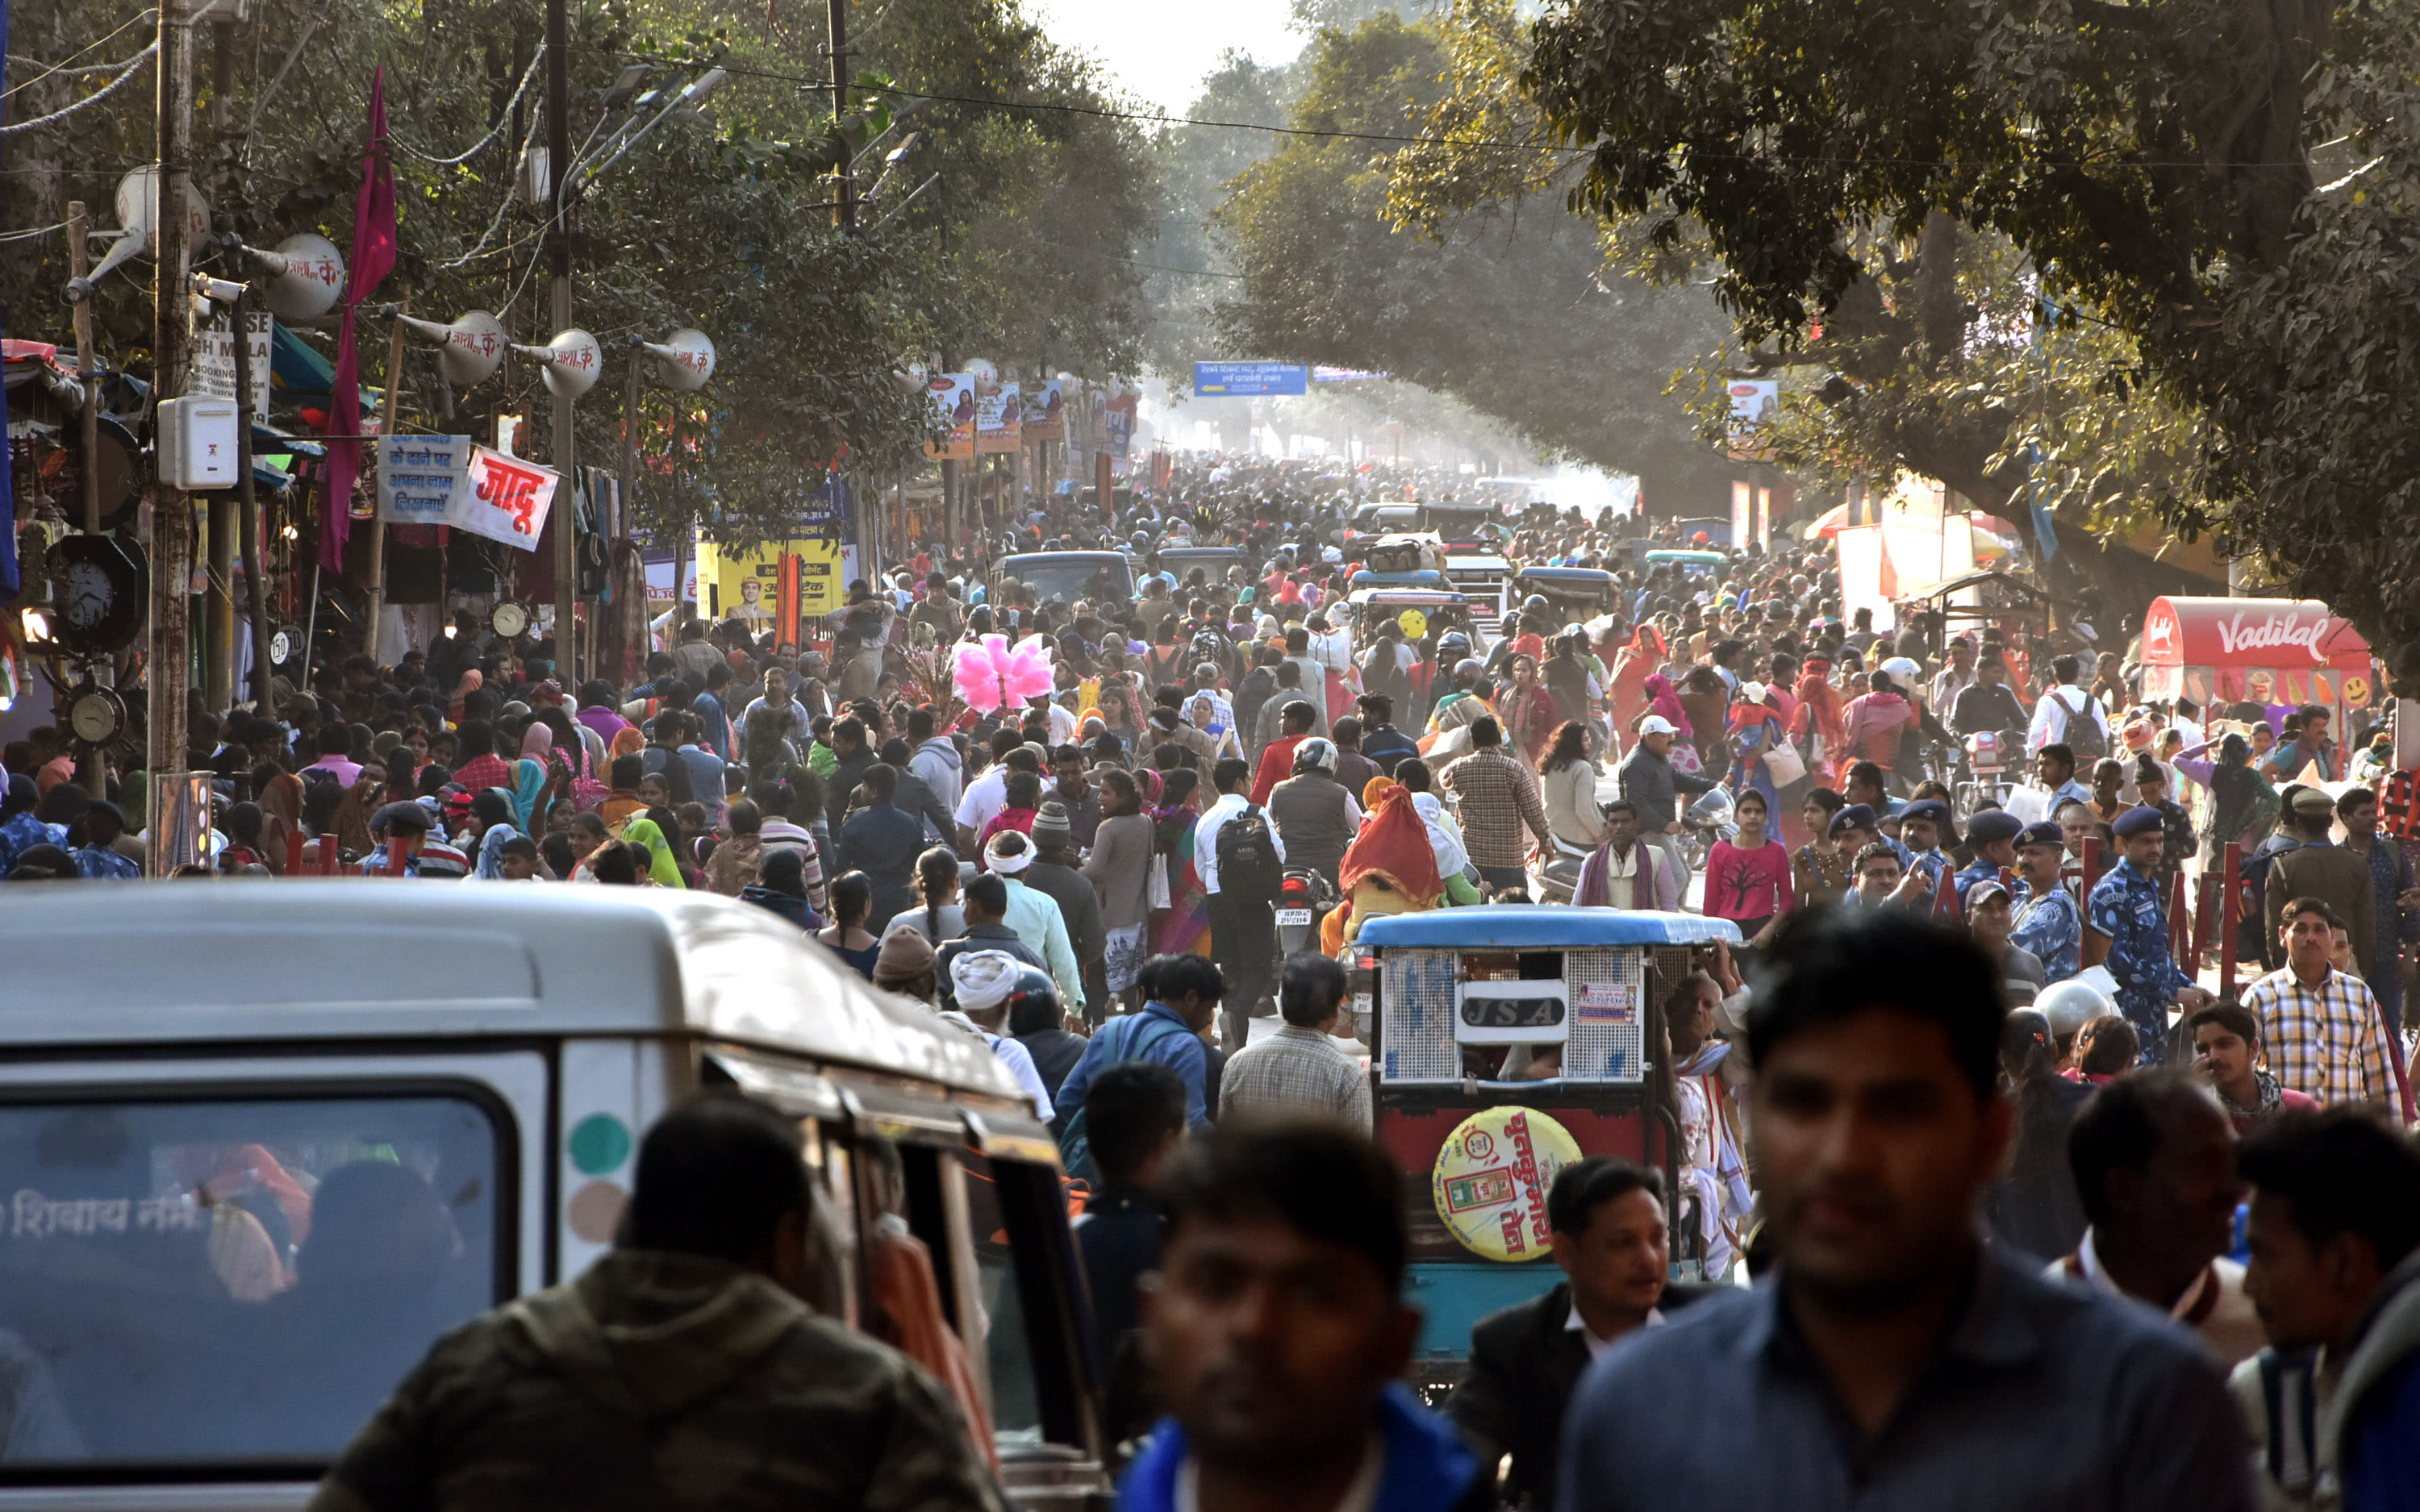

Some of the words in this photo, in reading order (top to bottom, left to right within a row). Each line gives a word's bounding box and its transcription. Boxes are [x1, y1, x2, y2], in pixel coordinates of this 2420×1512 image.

[219, 341, 268, 358] MLA
[476, 456, 545, 536] जादू
[2218, 610, 2330, 664] Vadilal
[1467, 999, 1555, 1025] JSA
[11, 1188, 129, 1239] शिवाय
[1500, 1208, 1526, 1256] तेल
